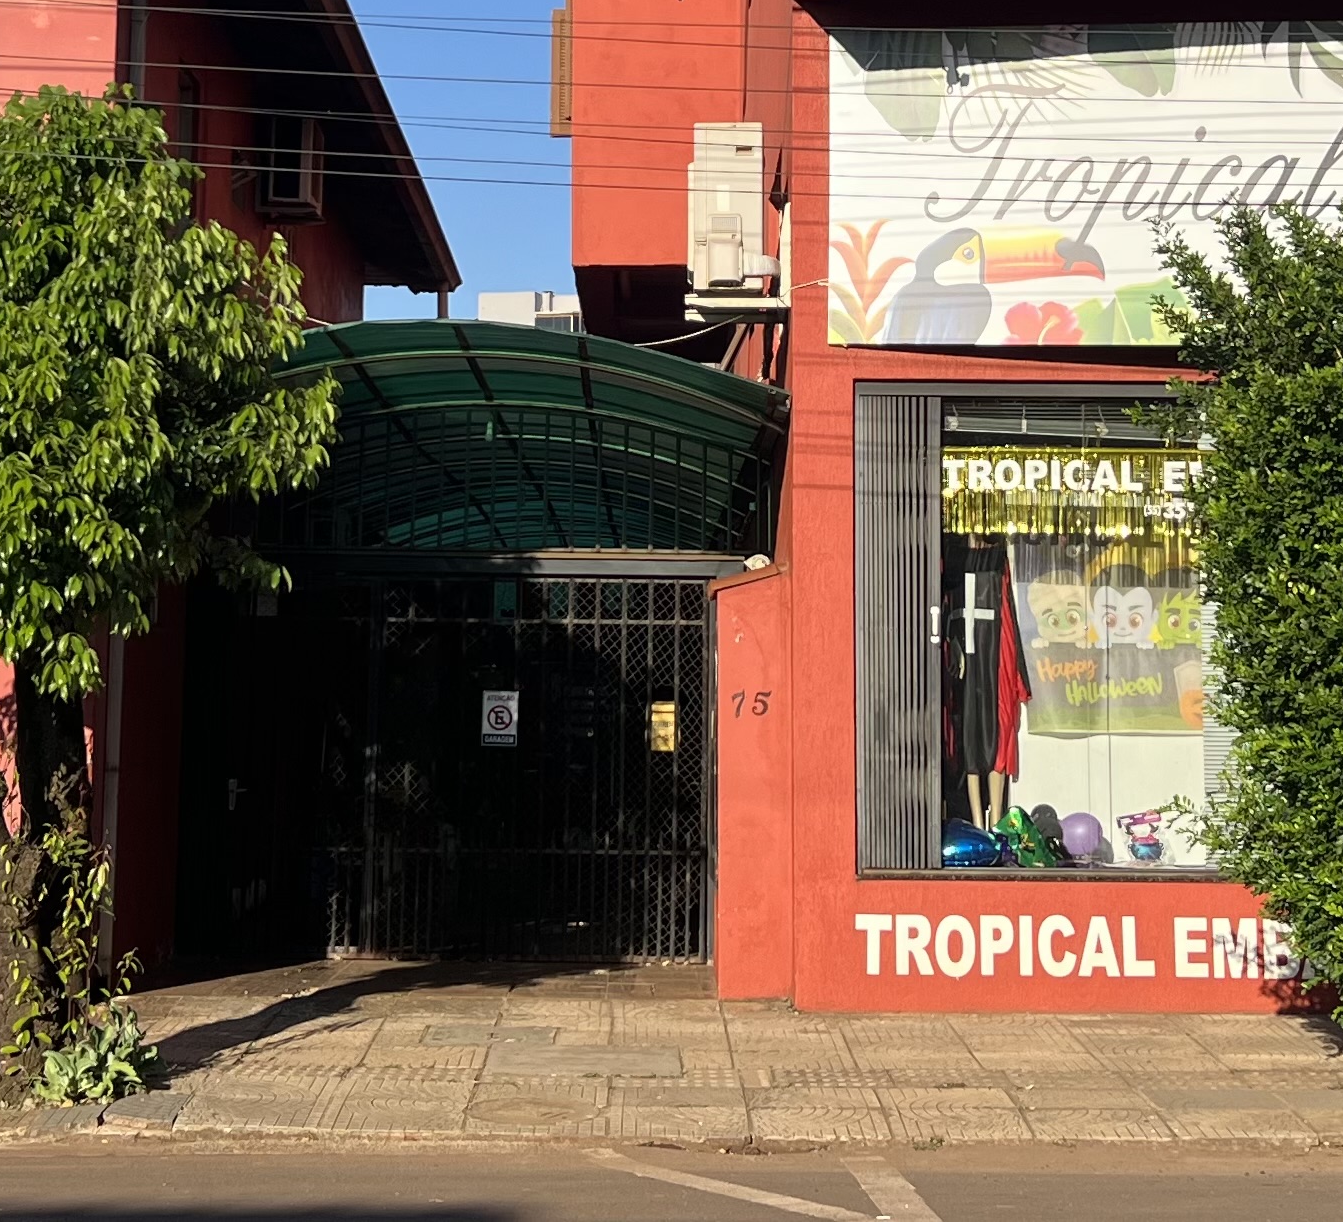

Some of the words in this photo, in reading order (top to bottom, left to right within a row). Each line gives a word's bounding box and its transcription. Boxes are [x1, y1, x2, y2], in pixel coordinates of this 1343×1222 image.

[942, 459, 1144, 492] TROPICAL
[1036, 656, 1099, 683] Happy
[731, 689, 773, 719] 75
[855, 913, 1156, 980] TROPICAL
